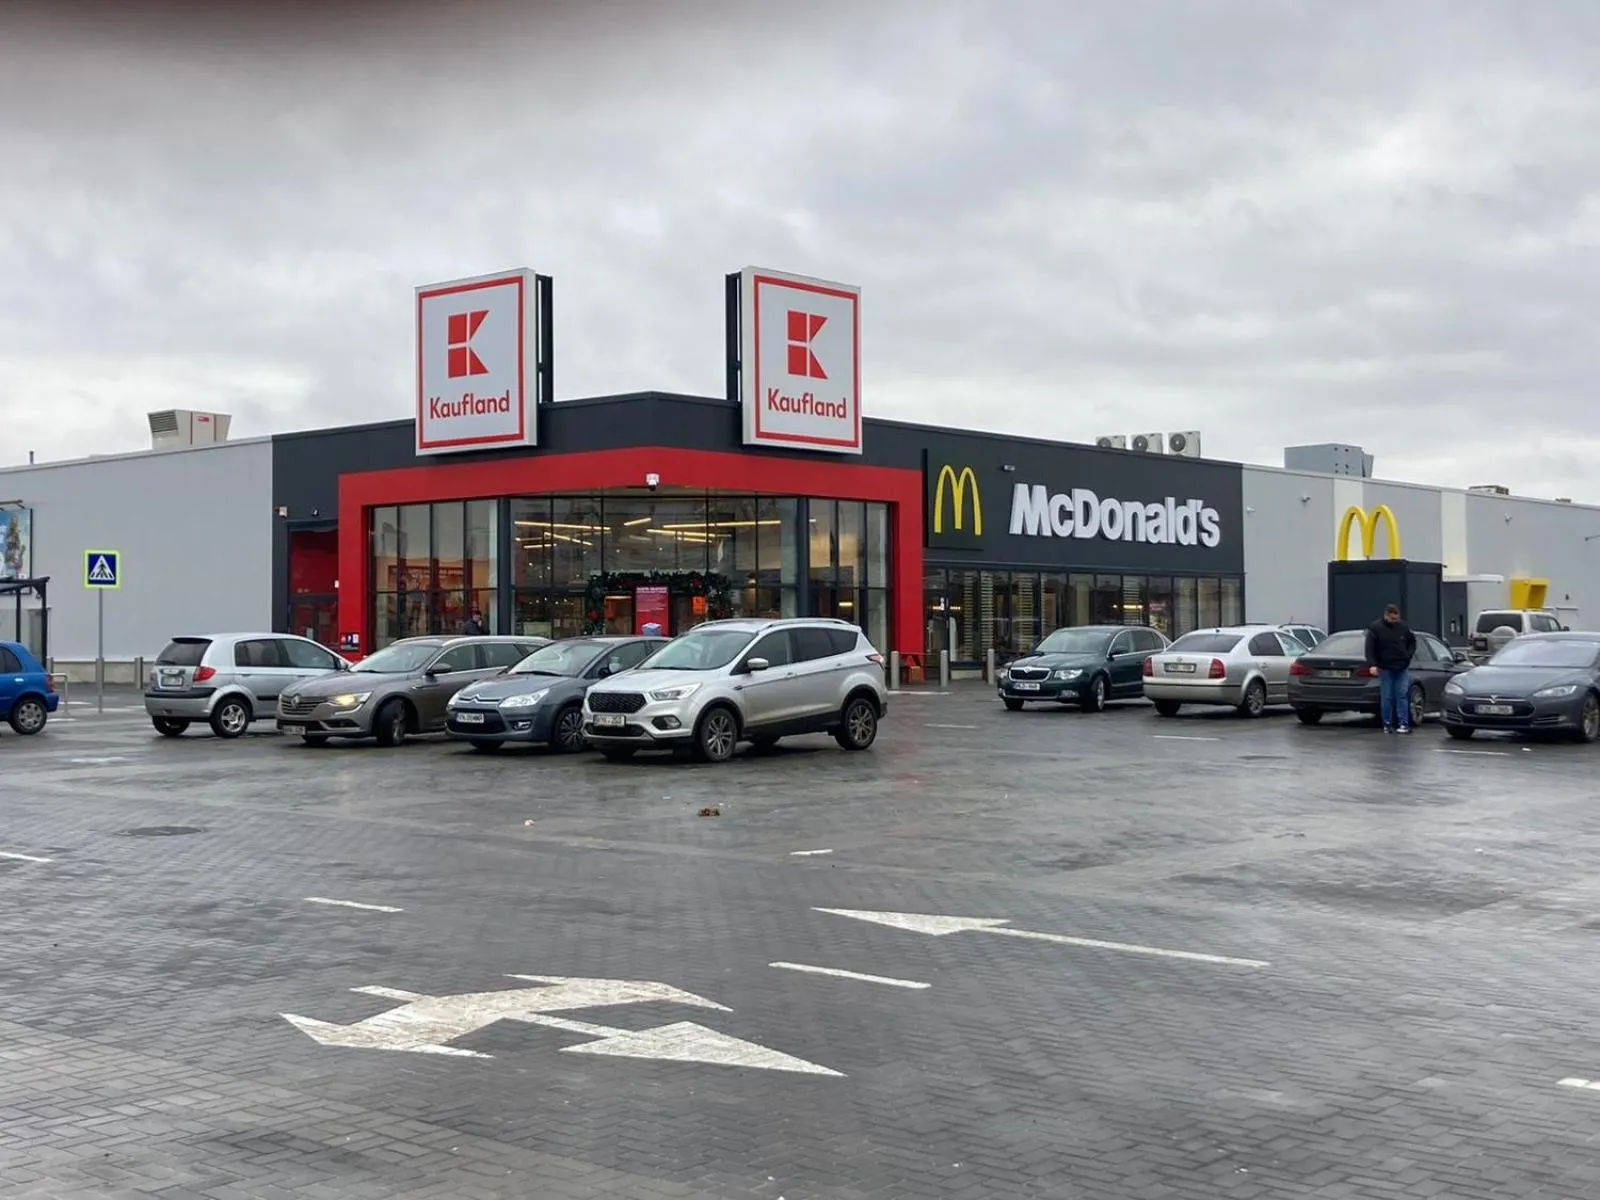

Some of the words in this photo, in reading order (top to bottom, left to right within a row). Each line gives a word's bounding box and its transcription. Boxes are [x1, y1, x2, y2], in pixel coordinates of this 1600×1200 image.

[448, 309, 490, 379] K
[787, 310, 828, 379] K
[430, 389, 510, 419] Kaufland
[768, 387, 847, 419] Kaufland
[1009, 483, 1220, 547] McDonald's
